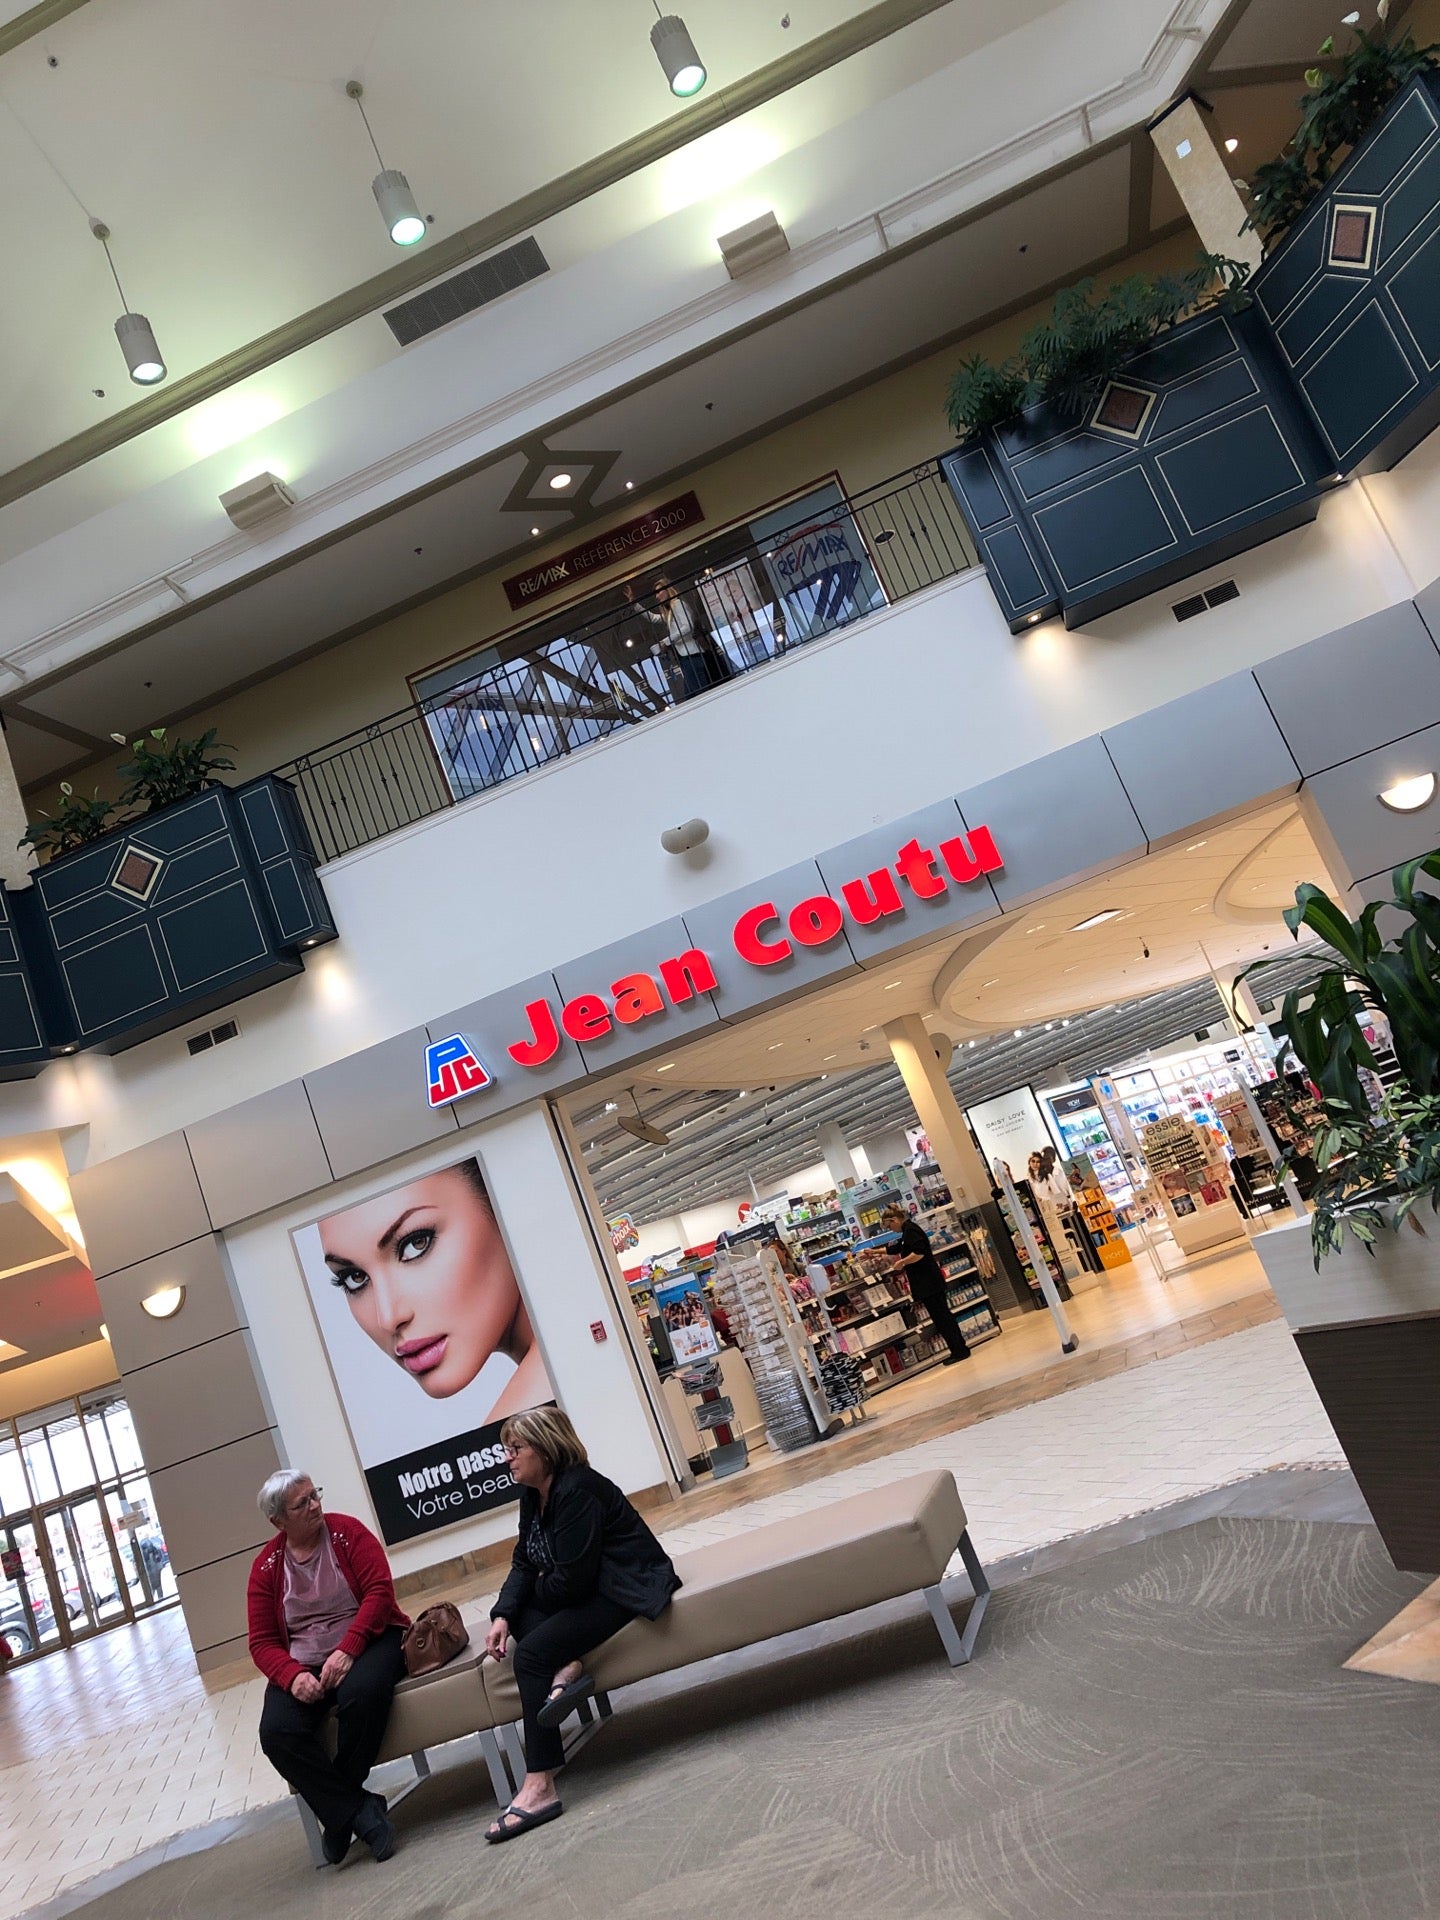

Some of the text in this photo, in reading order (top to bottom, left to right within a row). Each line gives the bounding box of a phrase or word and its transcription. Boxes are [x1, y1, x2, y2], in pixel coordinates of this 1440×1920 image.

[518, 508, 686, 597] RE/MAX RÉFÉRENCE 2000
[776, 531, 850, 580] RE/MAX
[507, 824, 1004, 1067] Jean Coutu
[985, 1109, 1026, 1129] DAISY LOVE
[1145, 1117, 1181, 1136] essie
[611, 1222, 631, 1246] choix
[397, 1443, 506, 1498] Notre pass
[406, 1472, 519, 1519] Votre beau
